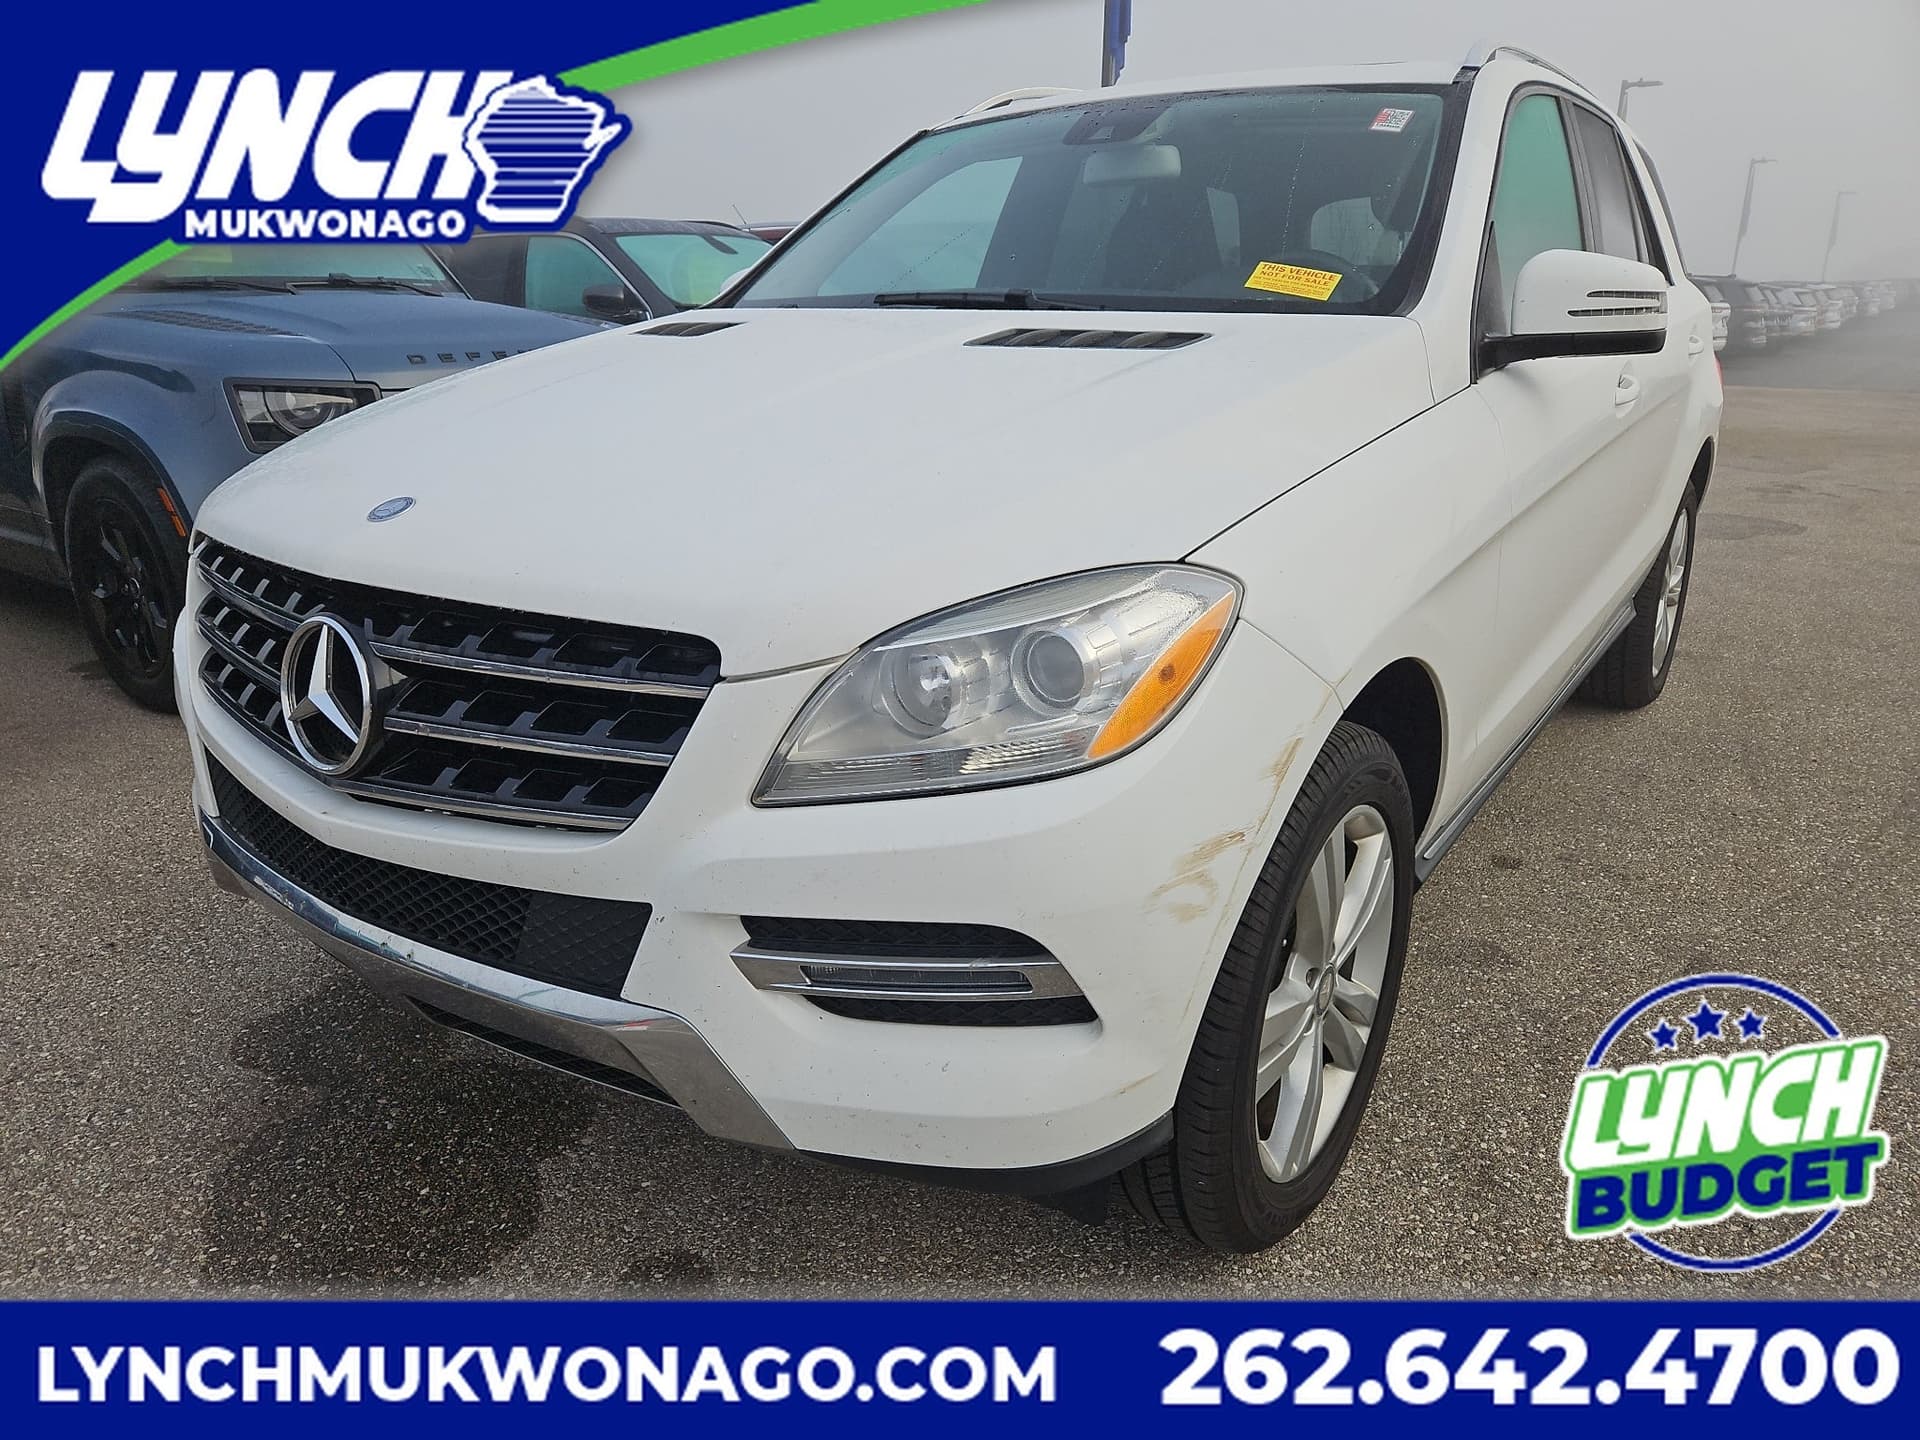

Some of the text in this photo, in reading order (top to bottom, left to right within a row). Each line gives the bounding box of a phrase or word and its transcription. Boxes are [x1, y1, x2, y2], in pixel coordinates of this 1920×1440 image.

[1260, 270, 1330, 287] NOT FOR SALE
[1262, 263, 1337, 282] THIS VEHICLE
[407, 349, 531, 365] DEFE
